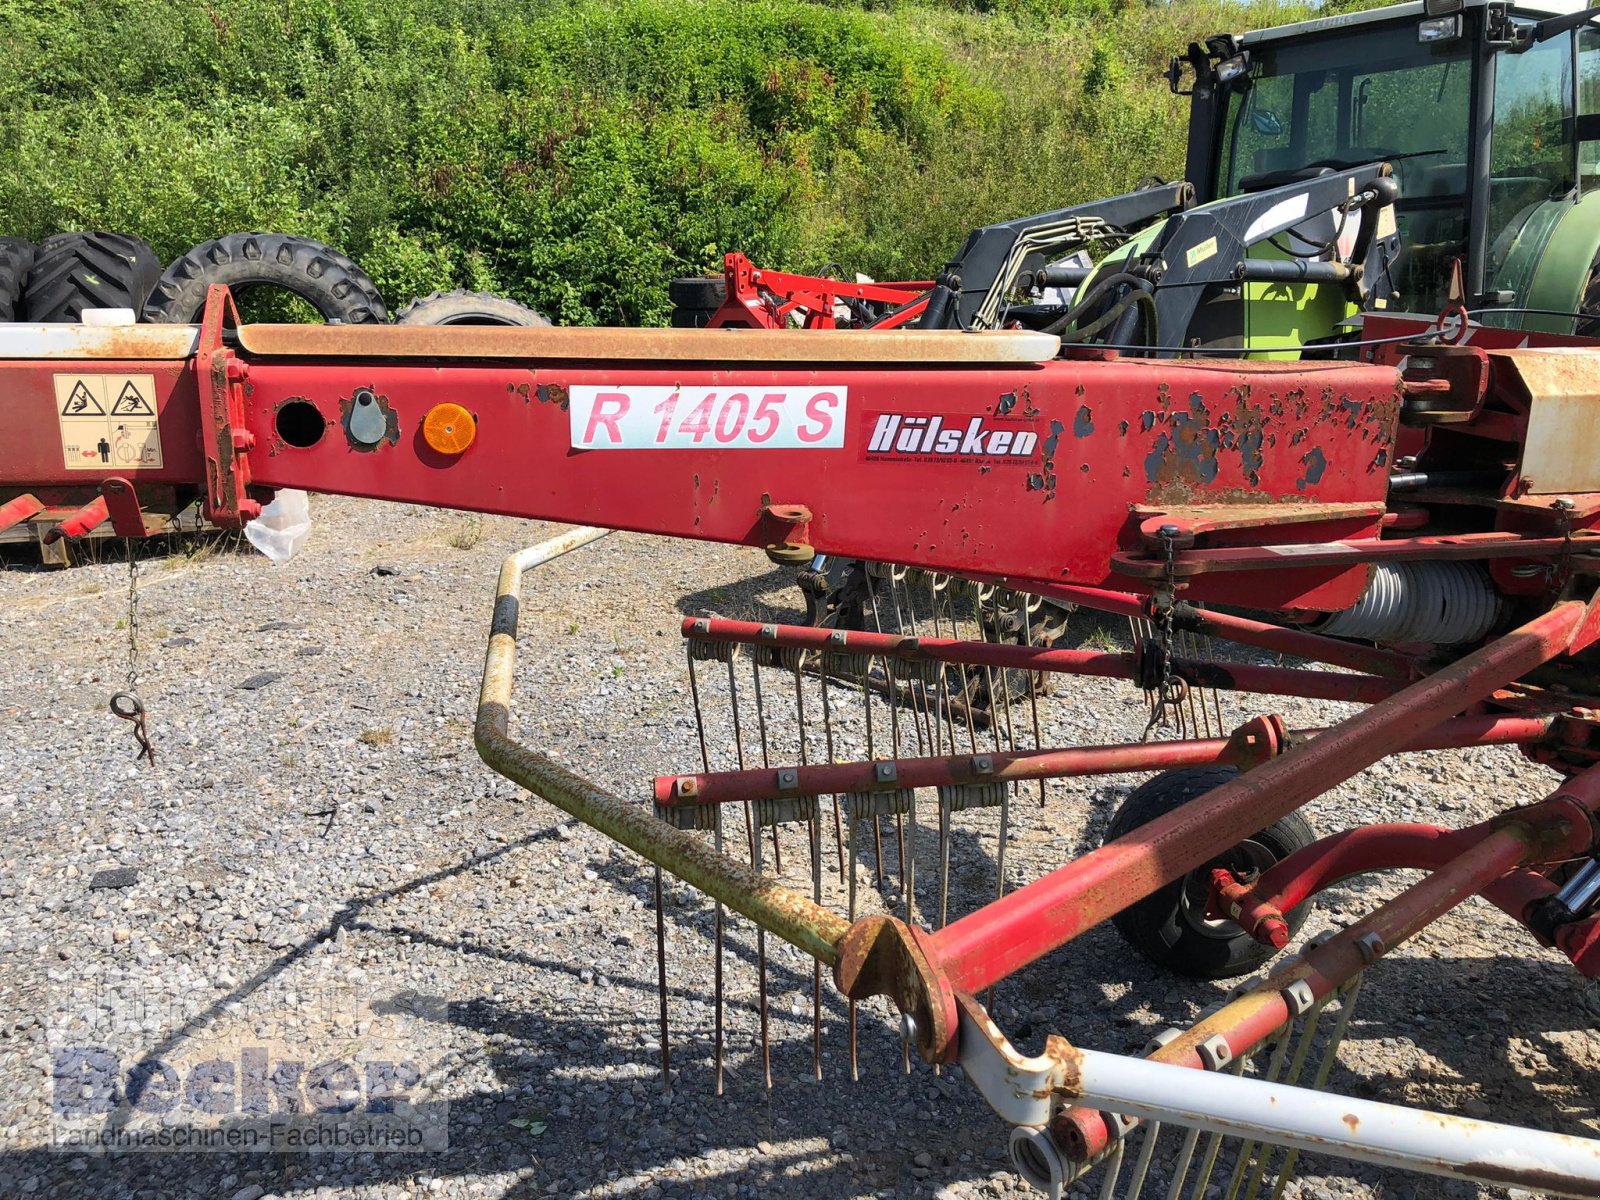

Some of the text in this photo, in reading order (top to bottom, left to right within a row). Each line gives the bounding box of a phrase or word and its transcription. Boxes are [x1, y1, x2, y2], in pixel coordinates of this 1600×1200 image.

[582, 392, 840, 444] R 1405 S
[866, 413, 1039, 457] Hülsken
